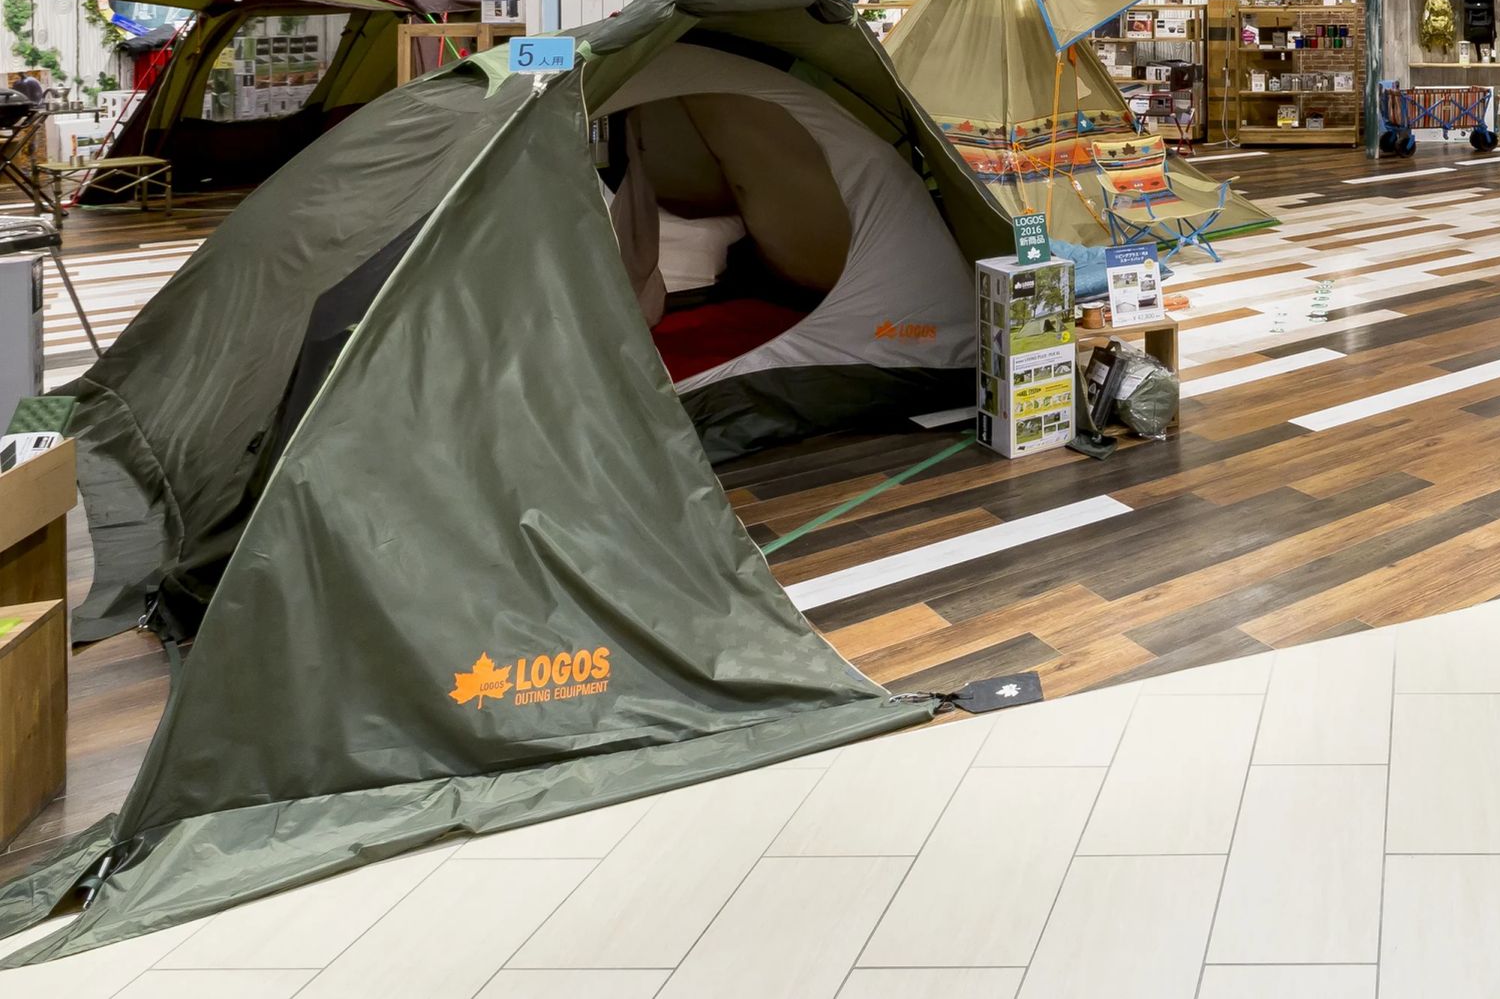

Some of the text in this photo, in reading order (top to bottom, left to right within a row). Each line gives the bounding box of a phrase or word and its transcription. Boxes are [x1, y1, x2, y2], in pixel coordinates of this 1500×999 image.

[517, 43, 564, 67] 5人用
[1015, 215, 1045, 227] LOGOS
[1021, 226, 1042, 237] 2016
[1019, 235, 1046, 247] 新商品
[516, 646, 611, 691] LOGOS
[479, 680, 505, 691] LOGOS
[514, 680, 609, 706] OUTING EQUIPMENT
